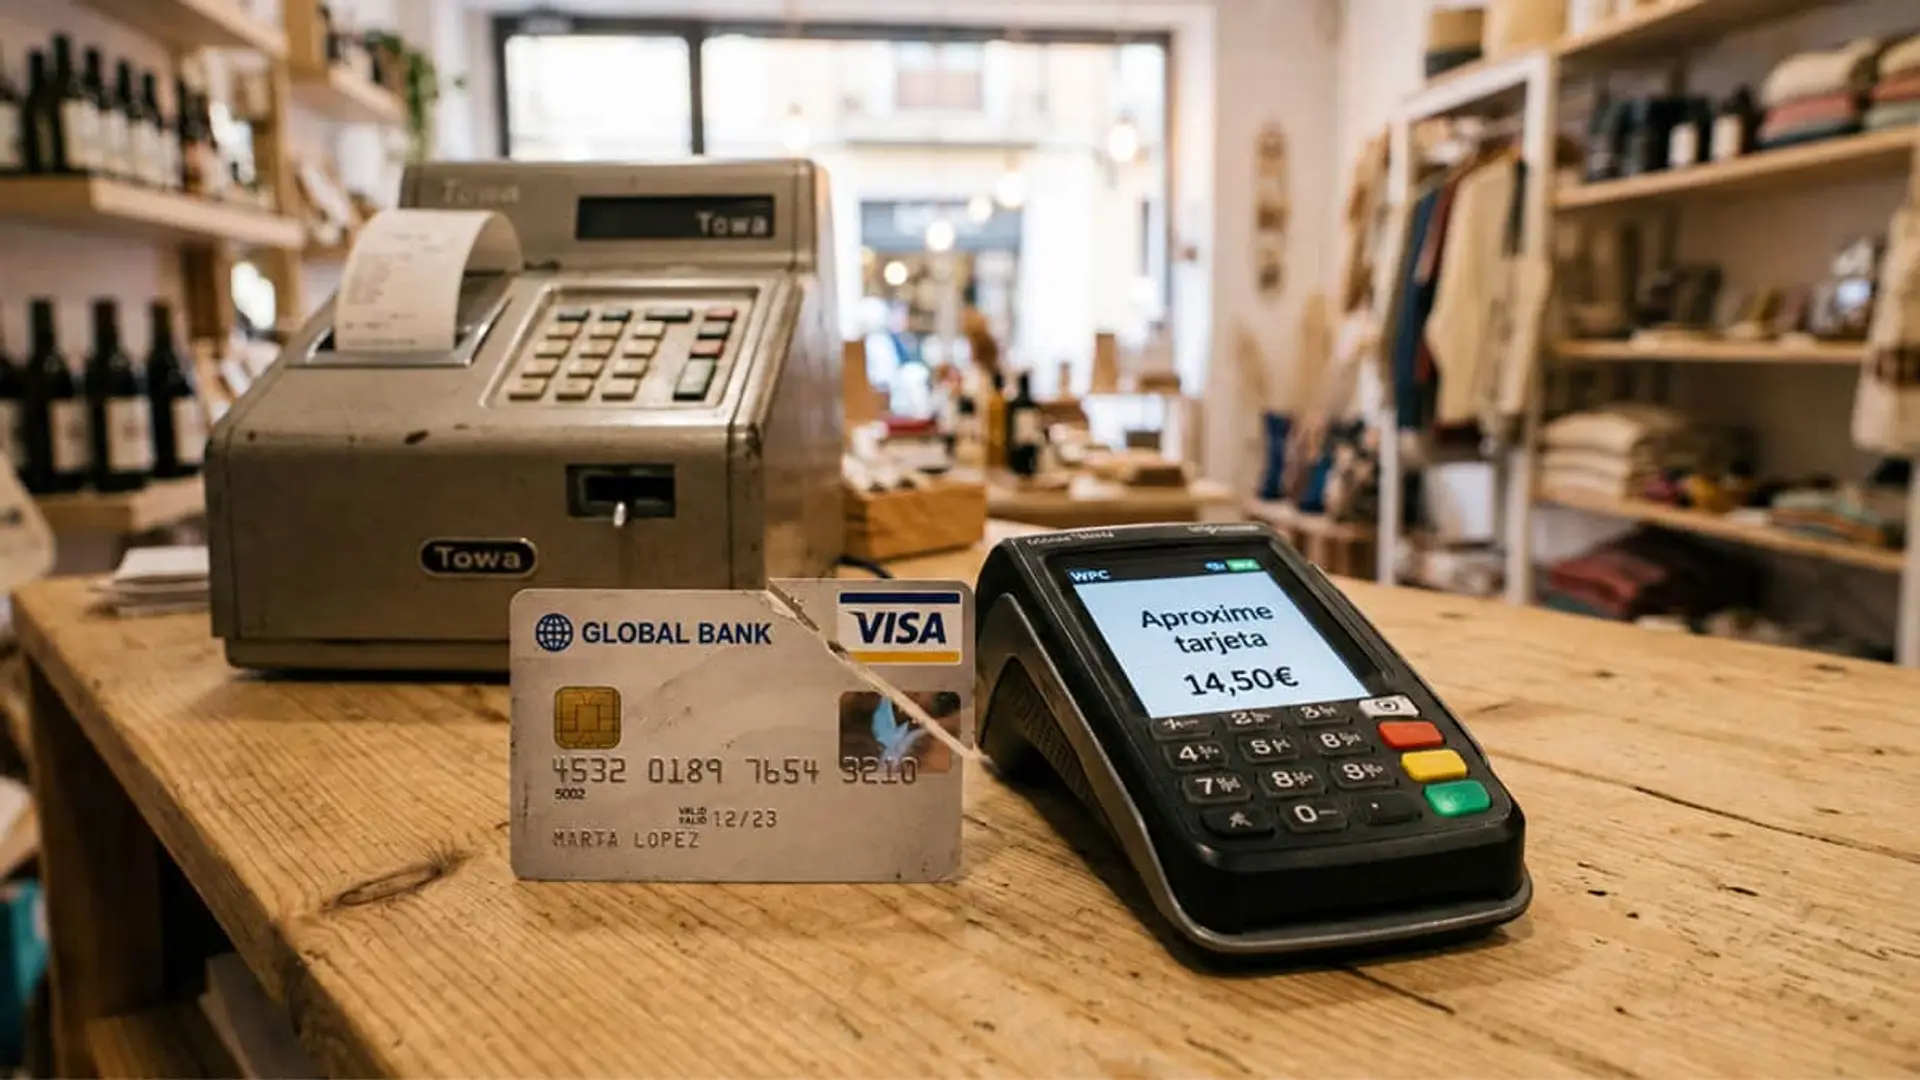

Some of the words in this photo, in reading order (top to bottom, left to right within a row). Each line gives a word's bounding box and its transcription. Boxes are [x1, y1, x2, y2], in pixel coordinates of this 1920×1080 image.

[695, 211, 768, 236] Towa
[433, 546, 521, 569] Towa
[847, 611, 947, 645] VISA
[1141, 604, 1275, 631] Aproxime
[582, 622, 690, 644] GLOBAL
[698, 622, 773, 645] BANK
[1174, 630, 1269, 655] tarjeta
[1184, 665, 1300, 697] 14,50€
[1179, 745, 1199, 762] 4
[552, 756, 627, 785] 4532
[647, 756, 723, 785] 0189
[744, 757, 820, 785] 7654
[842, 756, 919, 785] 3210
[1272, 770, 1295, 788] 8
[554, 788, 587, 800] 5002
[1195, 777, 1213, 795] 7
[713, 809, 778, 829] 12/23
[552, 830, 619, 849] MARTA
[634, 830, 700, 849] LOPEZ
